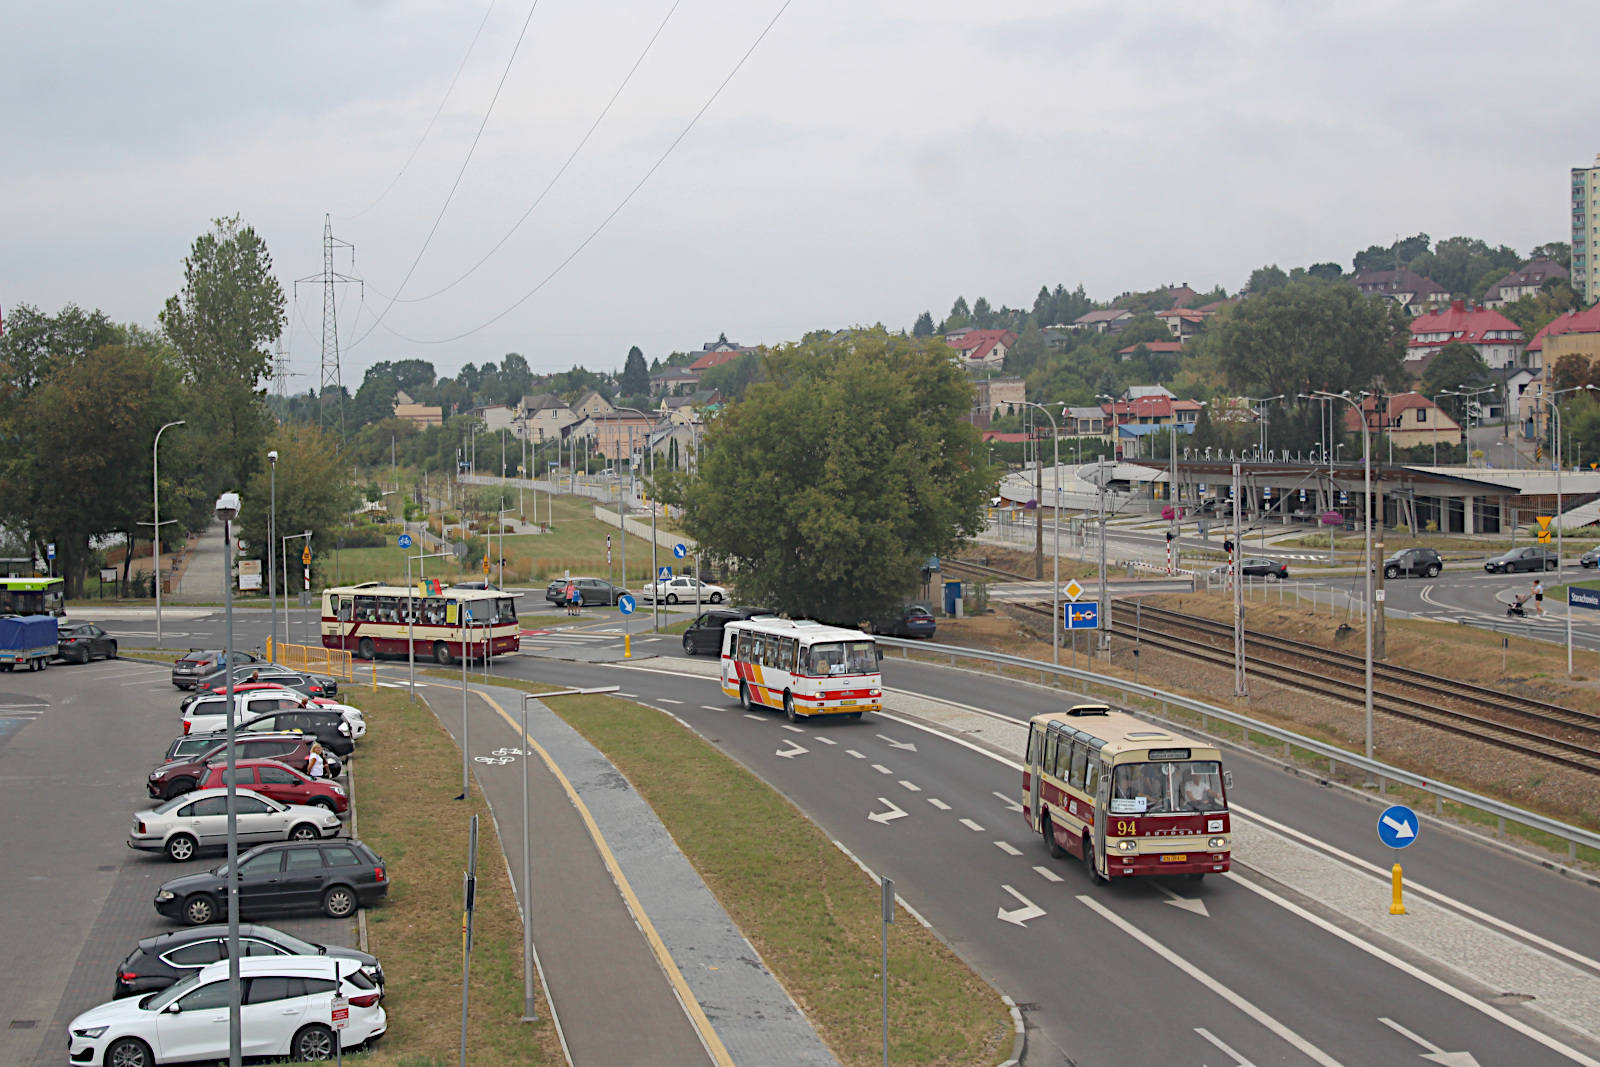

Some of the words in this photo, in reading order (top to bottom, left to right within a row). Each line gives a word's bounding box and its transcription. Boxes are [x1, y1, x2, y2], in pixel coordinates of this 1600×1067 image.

[1183, 447, 1329, 464] STARACHOWICE
[1571, 592, 1599, 606] Starachowice
[1117, 820, 1137, 836] 94
[1145, 829, 1202, 837] AUTOSAN
